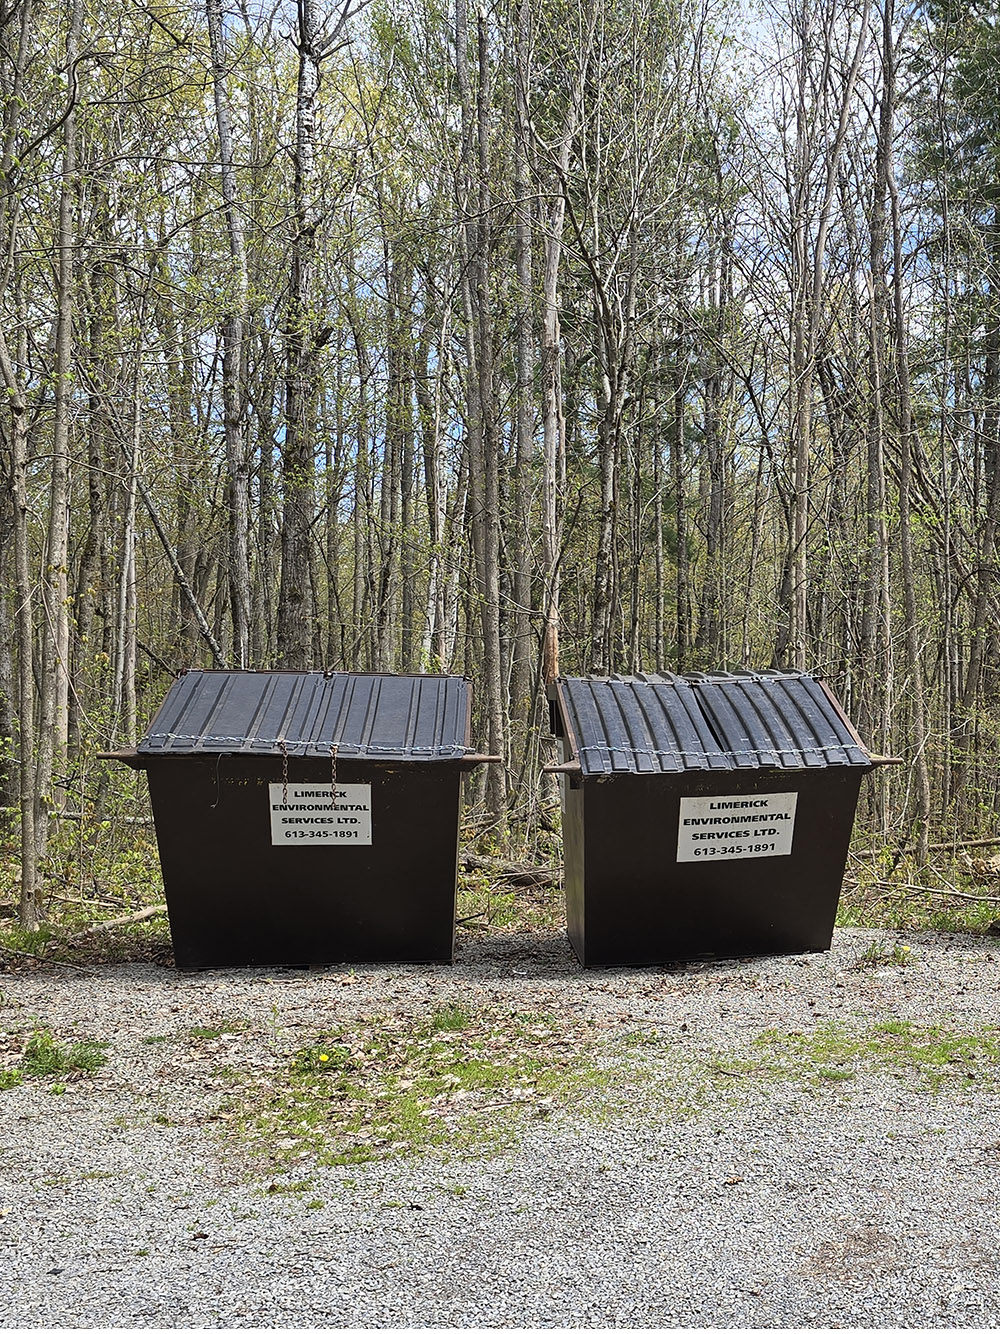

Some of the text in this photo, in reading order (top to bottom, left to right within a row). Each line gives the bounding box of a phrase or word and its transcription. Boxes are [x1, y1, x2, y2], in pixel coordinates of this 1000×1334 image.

[709, 800, 768, 810] LIMERICK
[683, 813, 791, 825] ENVIRONMENTAL
[691, 828, 780, 840] SERVICES LTD.
[694, 843, 775, 856] 613-345-1891
